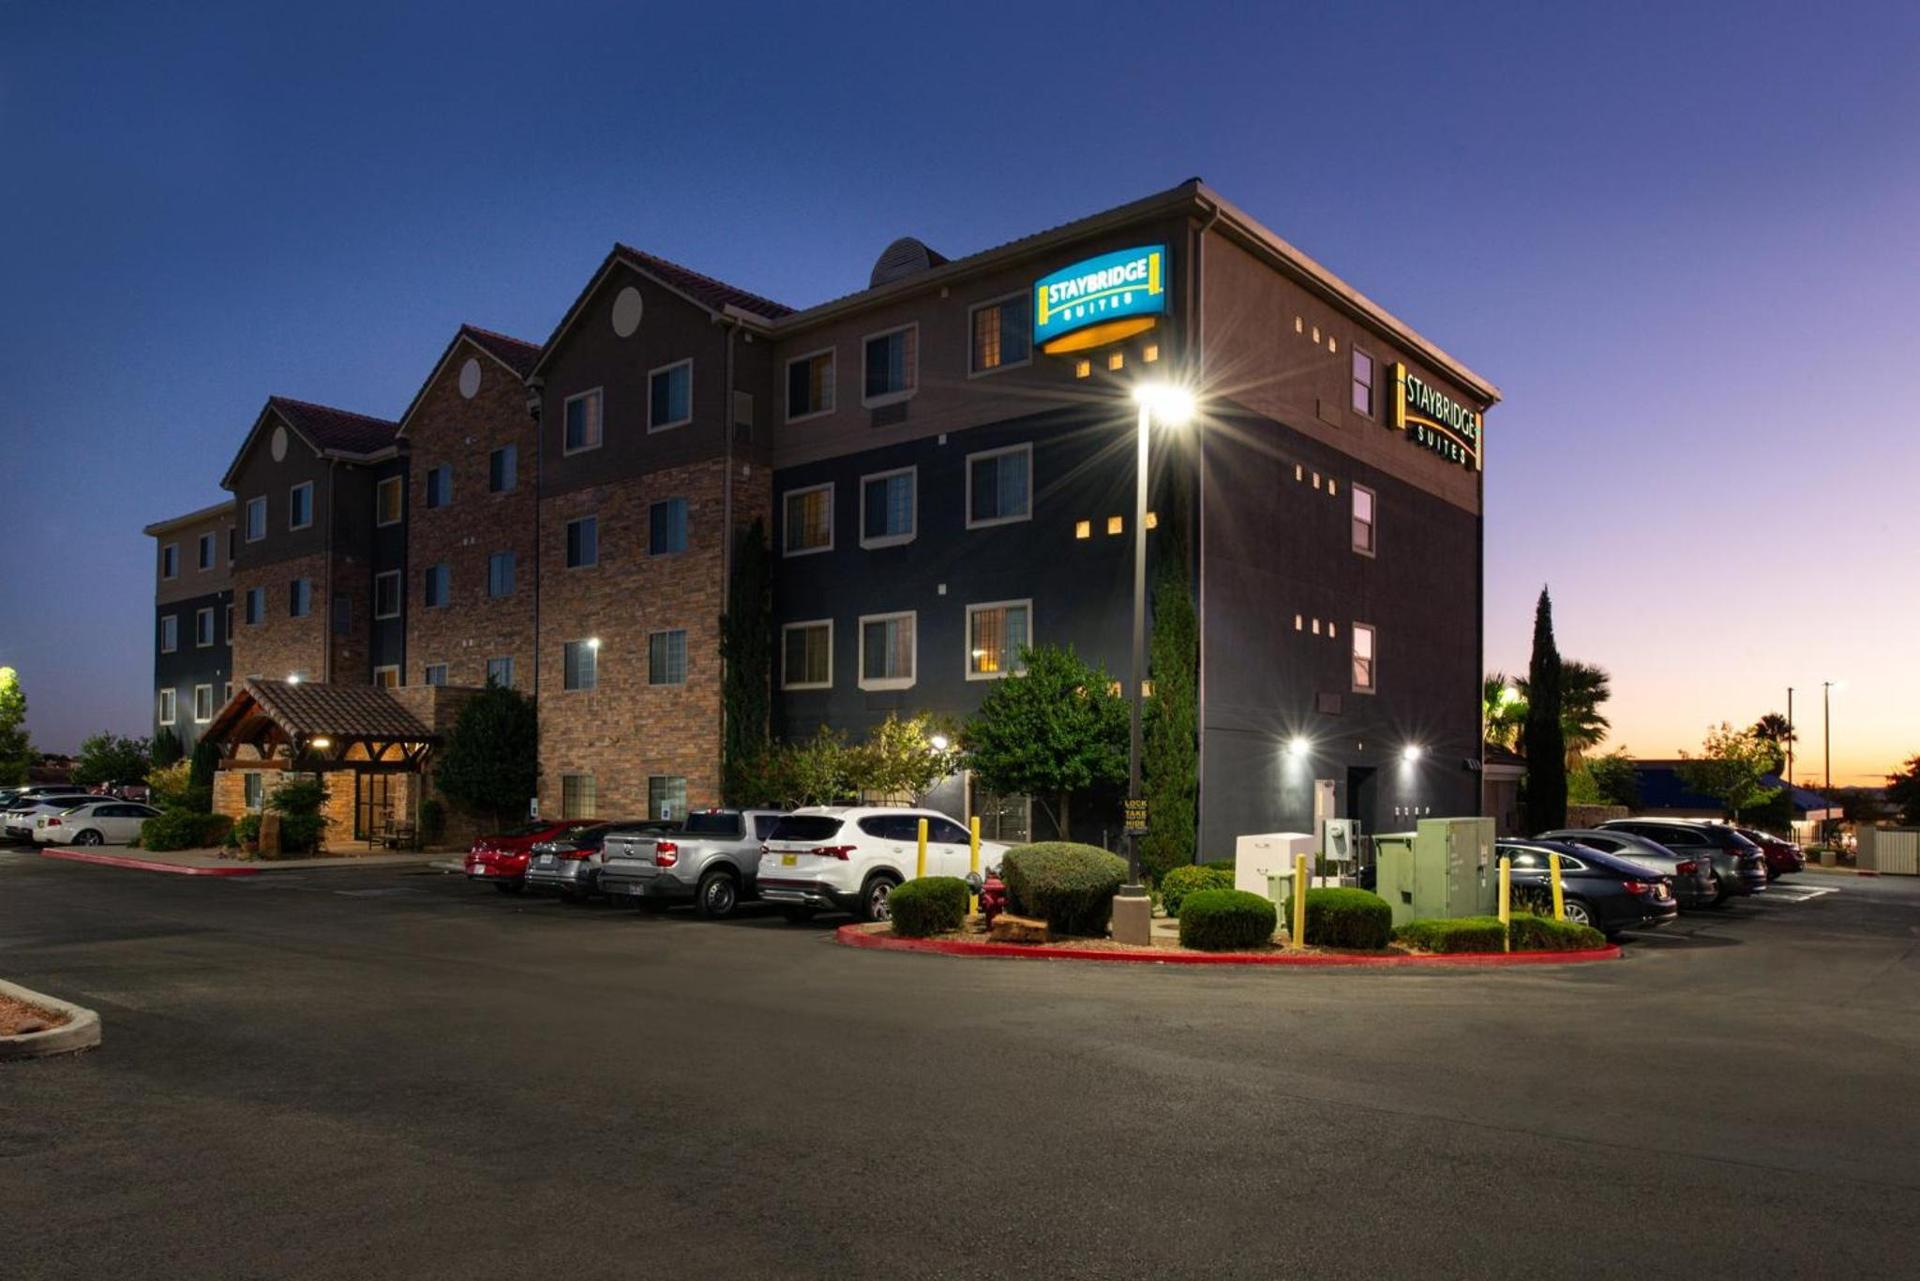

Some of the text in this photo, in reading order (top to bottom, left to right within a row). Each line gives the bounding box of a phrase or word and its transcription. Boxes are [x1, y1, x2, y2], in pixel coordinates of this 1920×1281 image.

[1049, 258, 1148, 304] STAYBRIDGE
[1063, 291, 1133, 322] SUITES
[1407, 373, 1475, 439] STAYBRIDGE
[1417, 424, 1466, 465] SUITES
[1124, 799, 1148, 808] LOCK
[1125, 820, 1146, 828] HIDE
